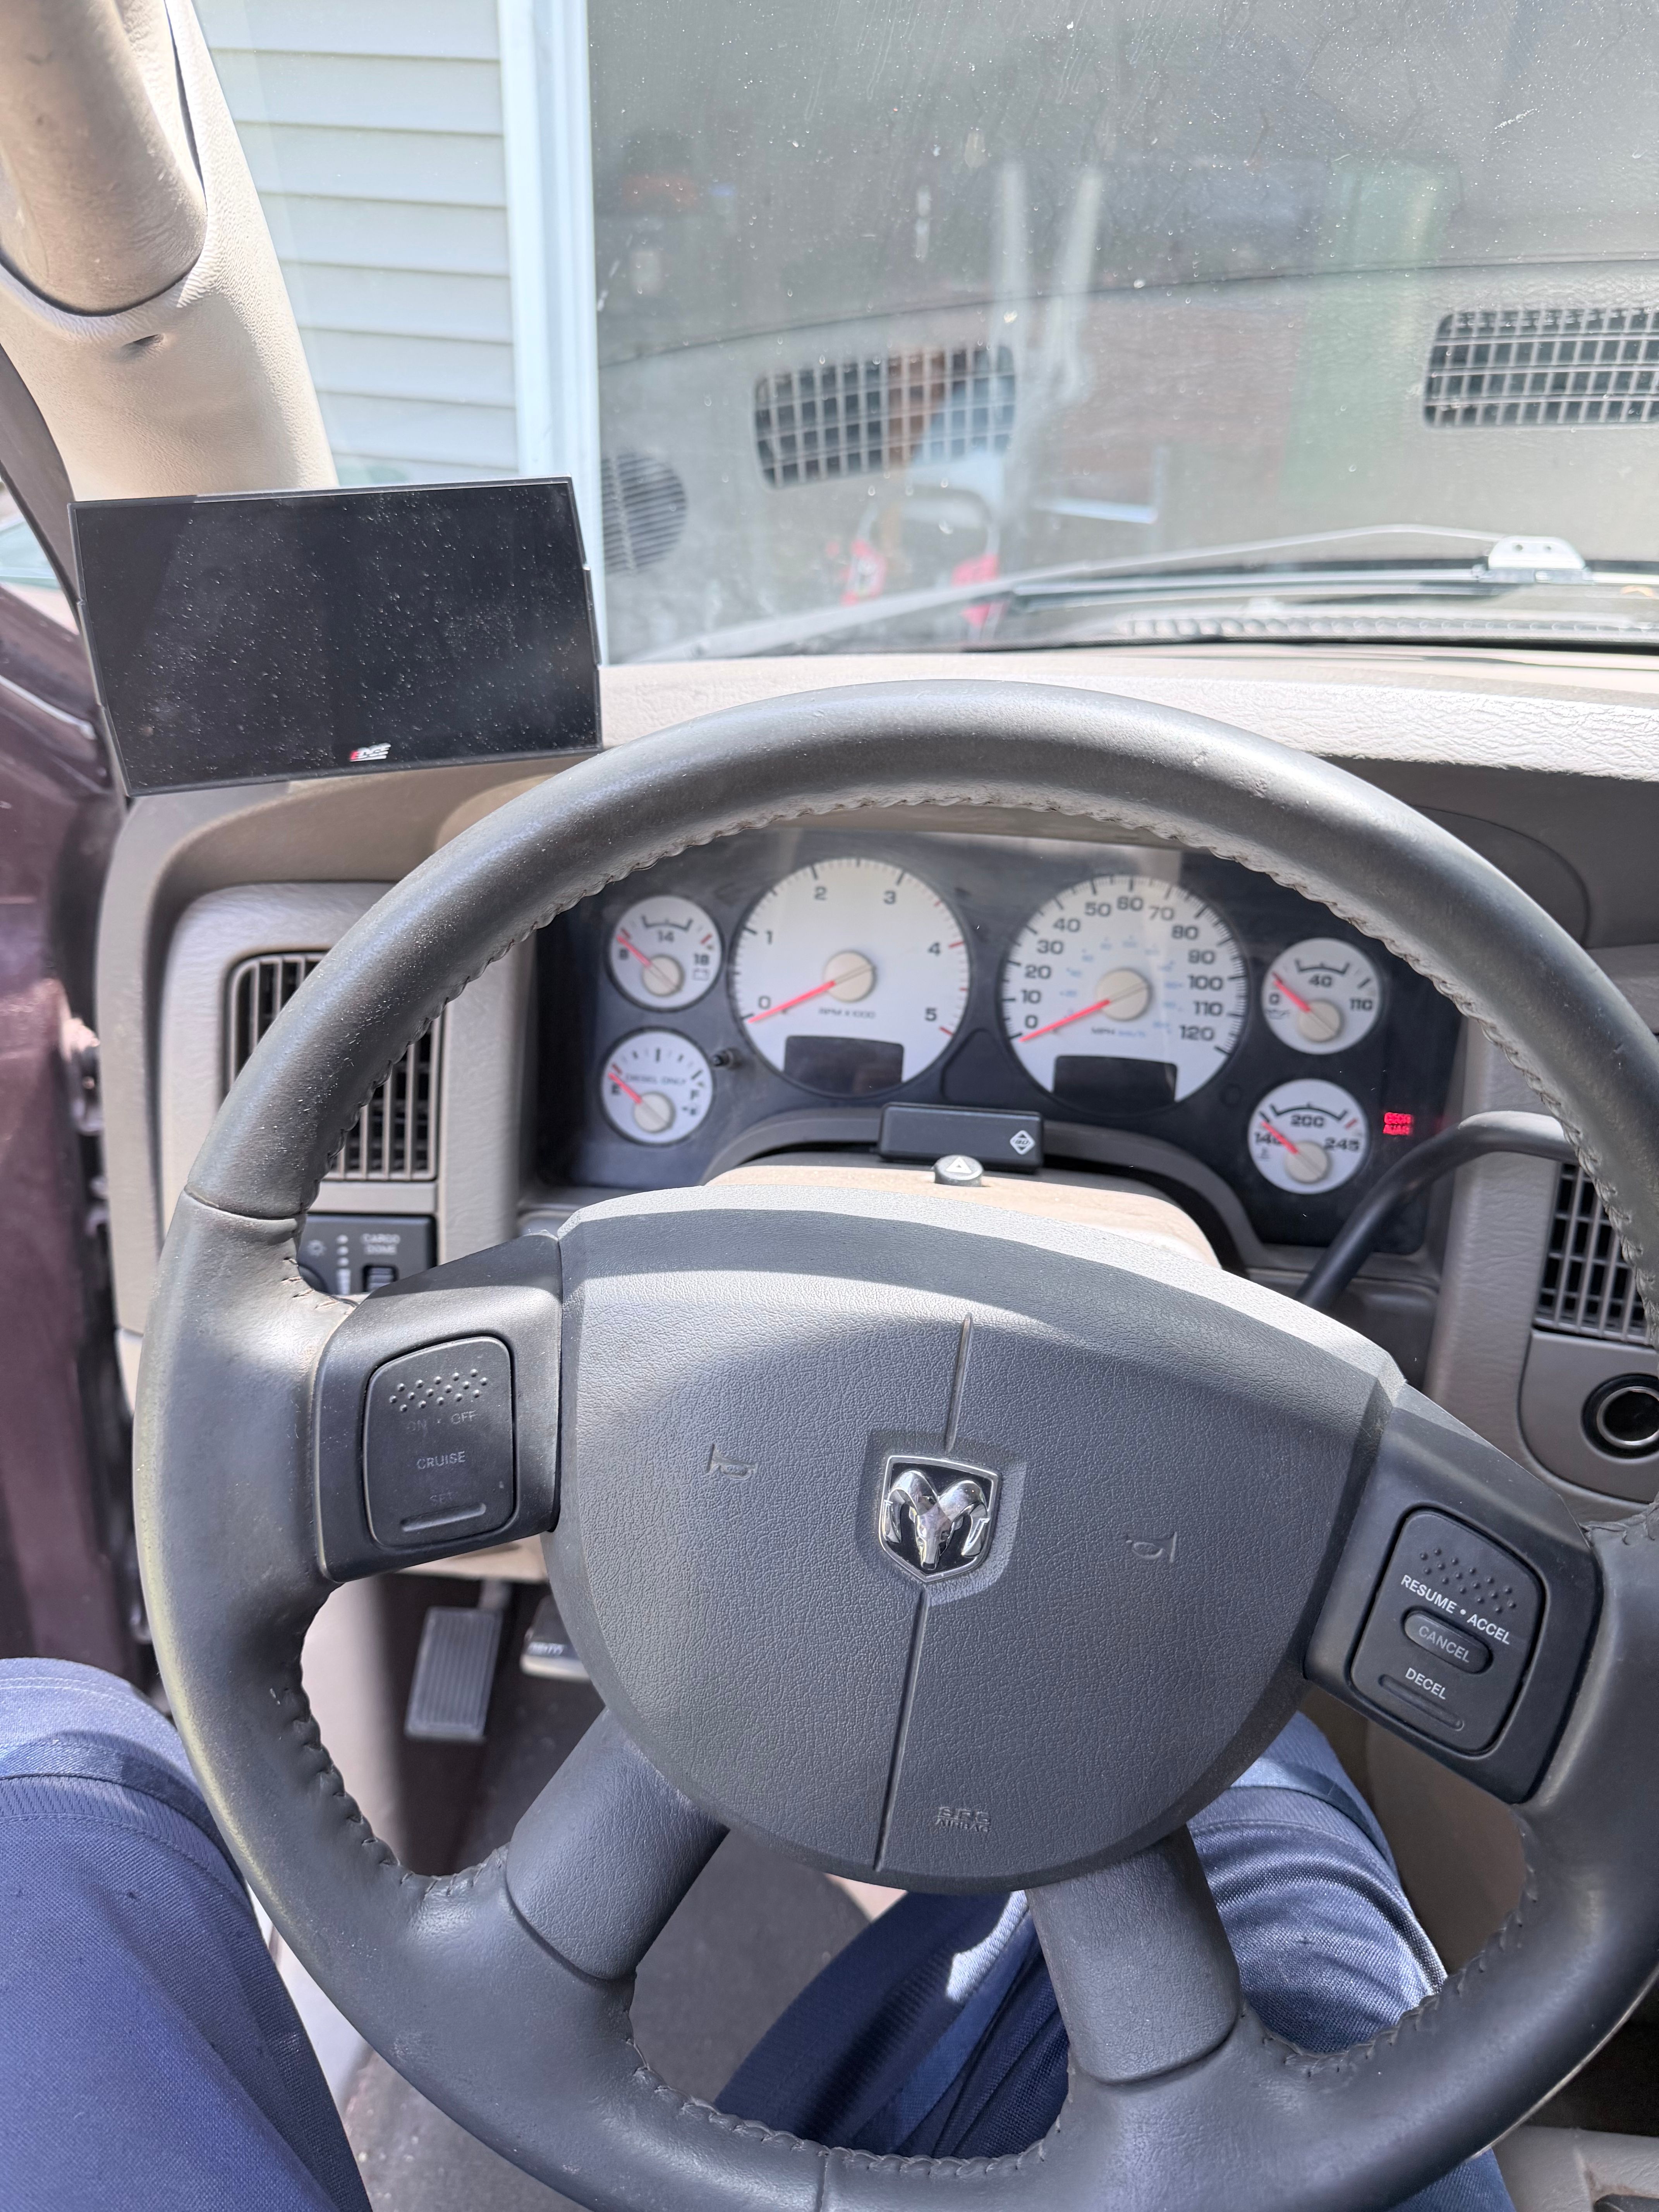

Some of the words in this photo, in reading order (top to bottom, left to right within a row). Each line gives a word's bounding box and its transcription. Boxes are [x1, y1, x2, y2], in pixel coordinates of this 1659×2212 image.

[814, 886, 827, 900] 2
[883, 890, 896, 905] 3
[1085, 902, 1111, 917] 50
[1117, 896, 1143, 911] 60
[1149, 905, 1174, 921] 70
[1053, 918, 1081, 933] 40
[1171, 925, 1199, 940] 80
[658, 931, 674, 942] 14
[766, 930, 773, 945] 1
[928, 941, 941, 956] 4
[1036, 939, 1064, 955] 30
[1188, 949, 1215, 965] 90
[1025, 964, 1051, 979] 20
[1188, 973, 1223, 991] 100
[1309, 974, 1332, 987] 40
[758, 995, 771, 1010] 0
[1021, 989, 1041, 1004] 10
[1269, 993, 1279, 1005] 0
[1350, 997, 1372, 1011] 110
[925, 1007, 937, 1022] 5
[1193, 1001, 1223, 1017] 110
[1024, 1015, 1038, 1029] 0
[1180, 1024, 1215, 1041] 120
[1291, 1114, 1325, 1128] 200
[1324, 1137, 1359, 1152] 245
[451, 1410, 478, 1424] OFF
[416, 1451, 466, 1470] CRUISE
[1400, 1574, 1457, 1615] RESUME
[1466, 1614, 1510, 1645] ACCEL
[1418, 1625, 1470, 1663] CANCEL
[1405, 1667, 1446, 1700] DECEL
